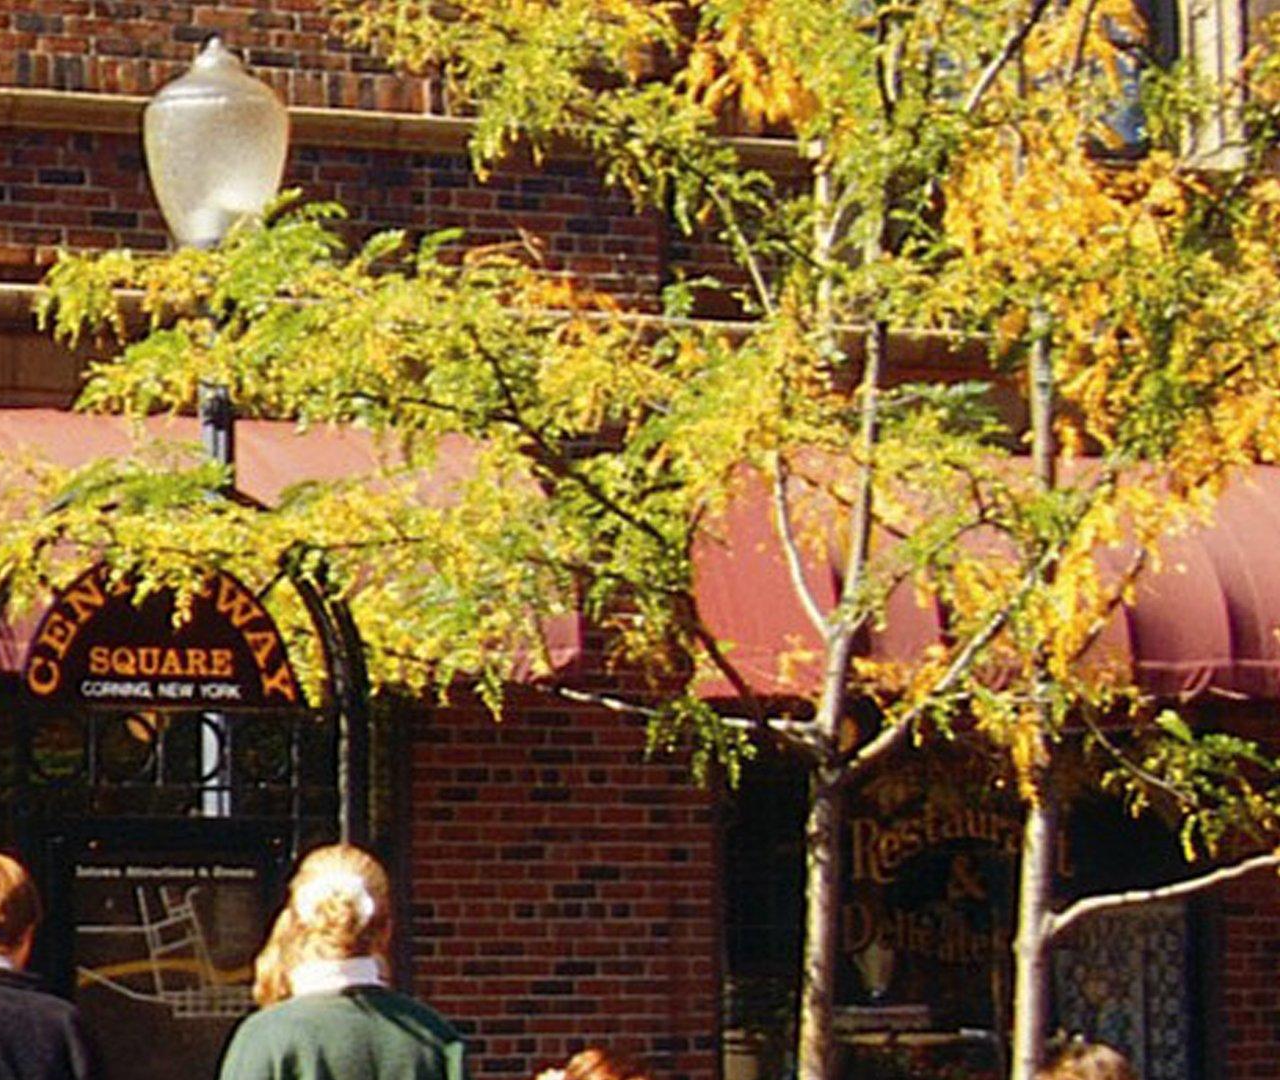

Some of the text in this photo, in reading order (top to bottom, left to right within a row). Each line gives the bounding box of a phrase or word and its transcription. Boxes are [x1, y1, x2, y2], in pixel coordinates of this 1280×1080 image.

[28, 562, 296, 702] CENWAY
[89, 645, 235, 677] SQUARE
[156, 681, 195, 698] NEW
[199, 683, 242, 699] YORK
